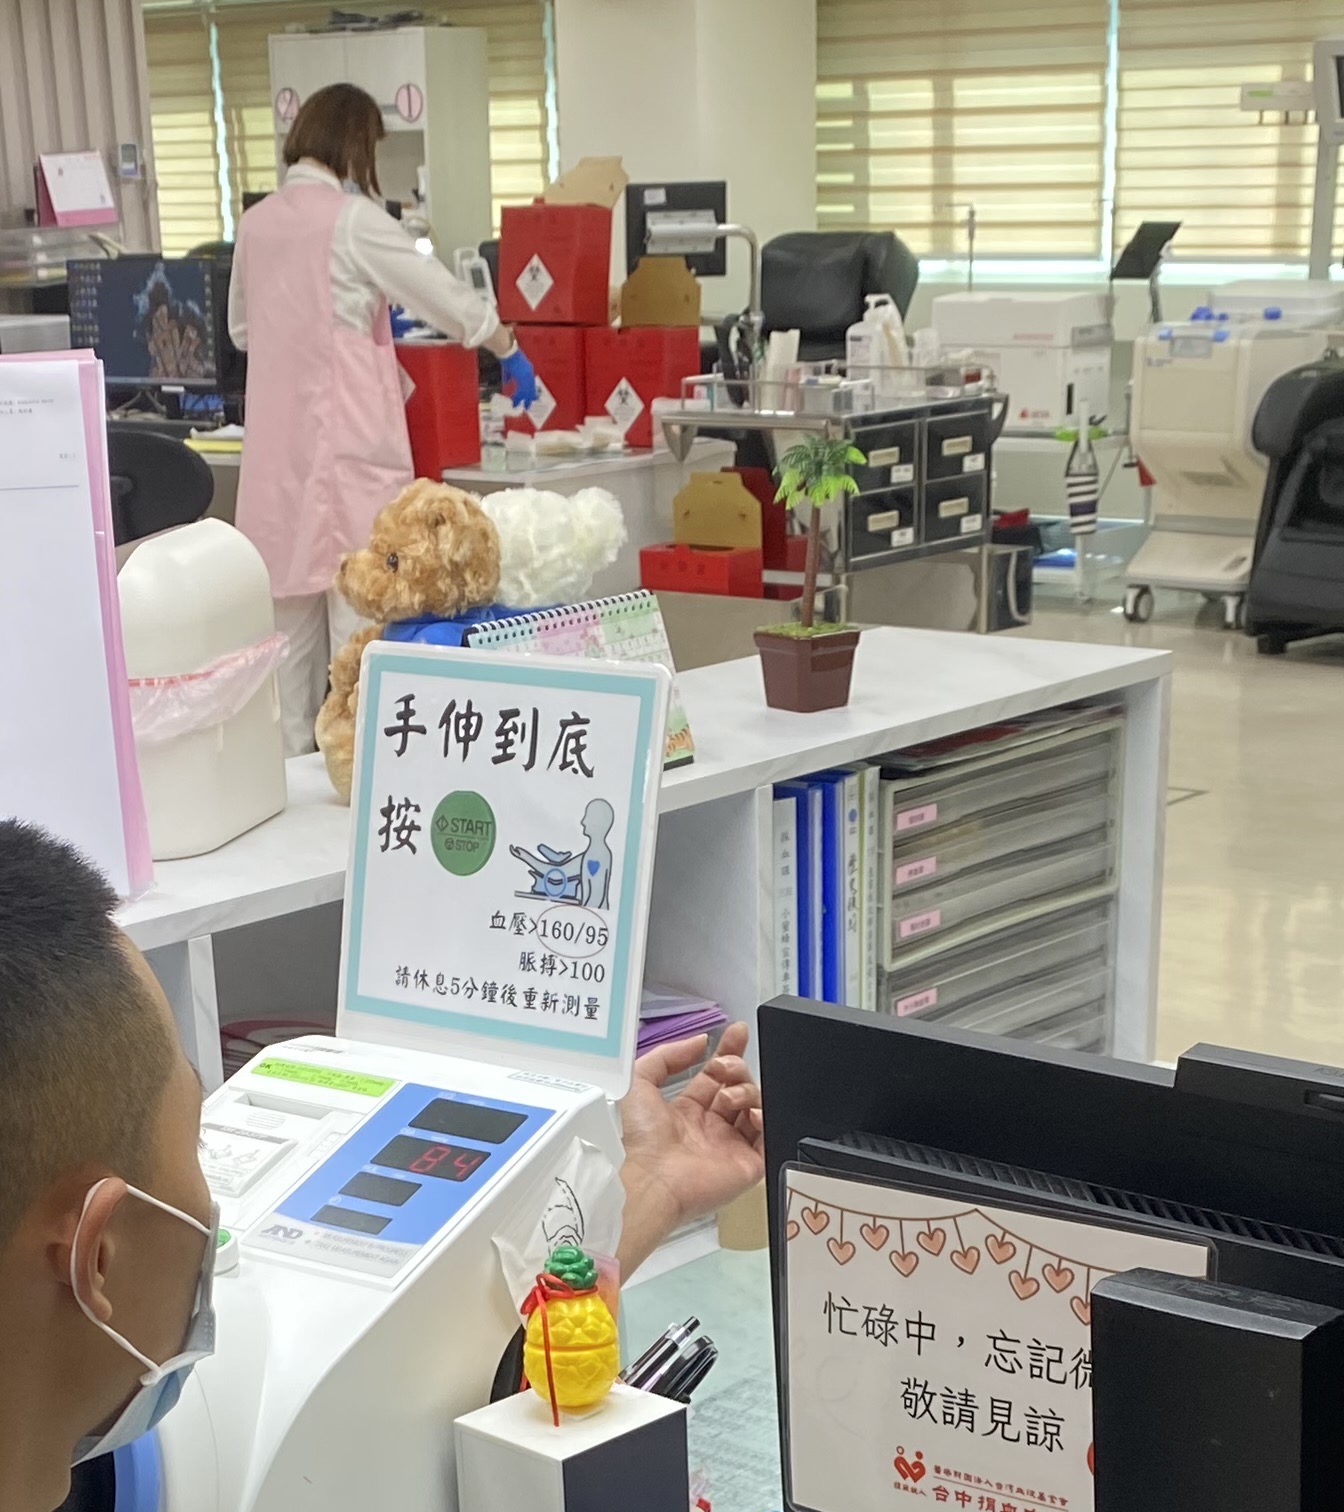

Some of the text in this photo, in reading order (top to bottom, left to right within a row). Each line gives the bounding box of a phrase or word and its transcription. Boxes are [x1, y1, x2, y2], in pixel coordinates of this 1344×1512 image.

[384, 692, 595, 778] 手伸到底
[378, 795, 492, 855] 按 START
[455, 839, 479, 852] STOP
[489, 910, 609, 948] 血壓>160/95
[395, 964, 601, 1022] 請休息5分鐘後重新測量
[409, 1145, 481, 1181] 84
[900, 1376, 1066, 1453] 敬請見諒
